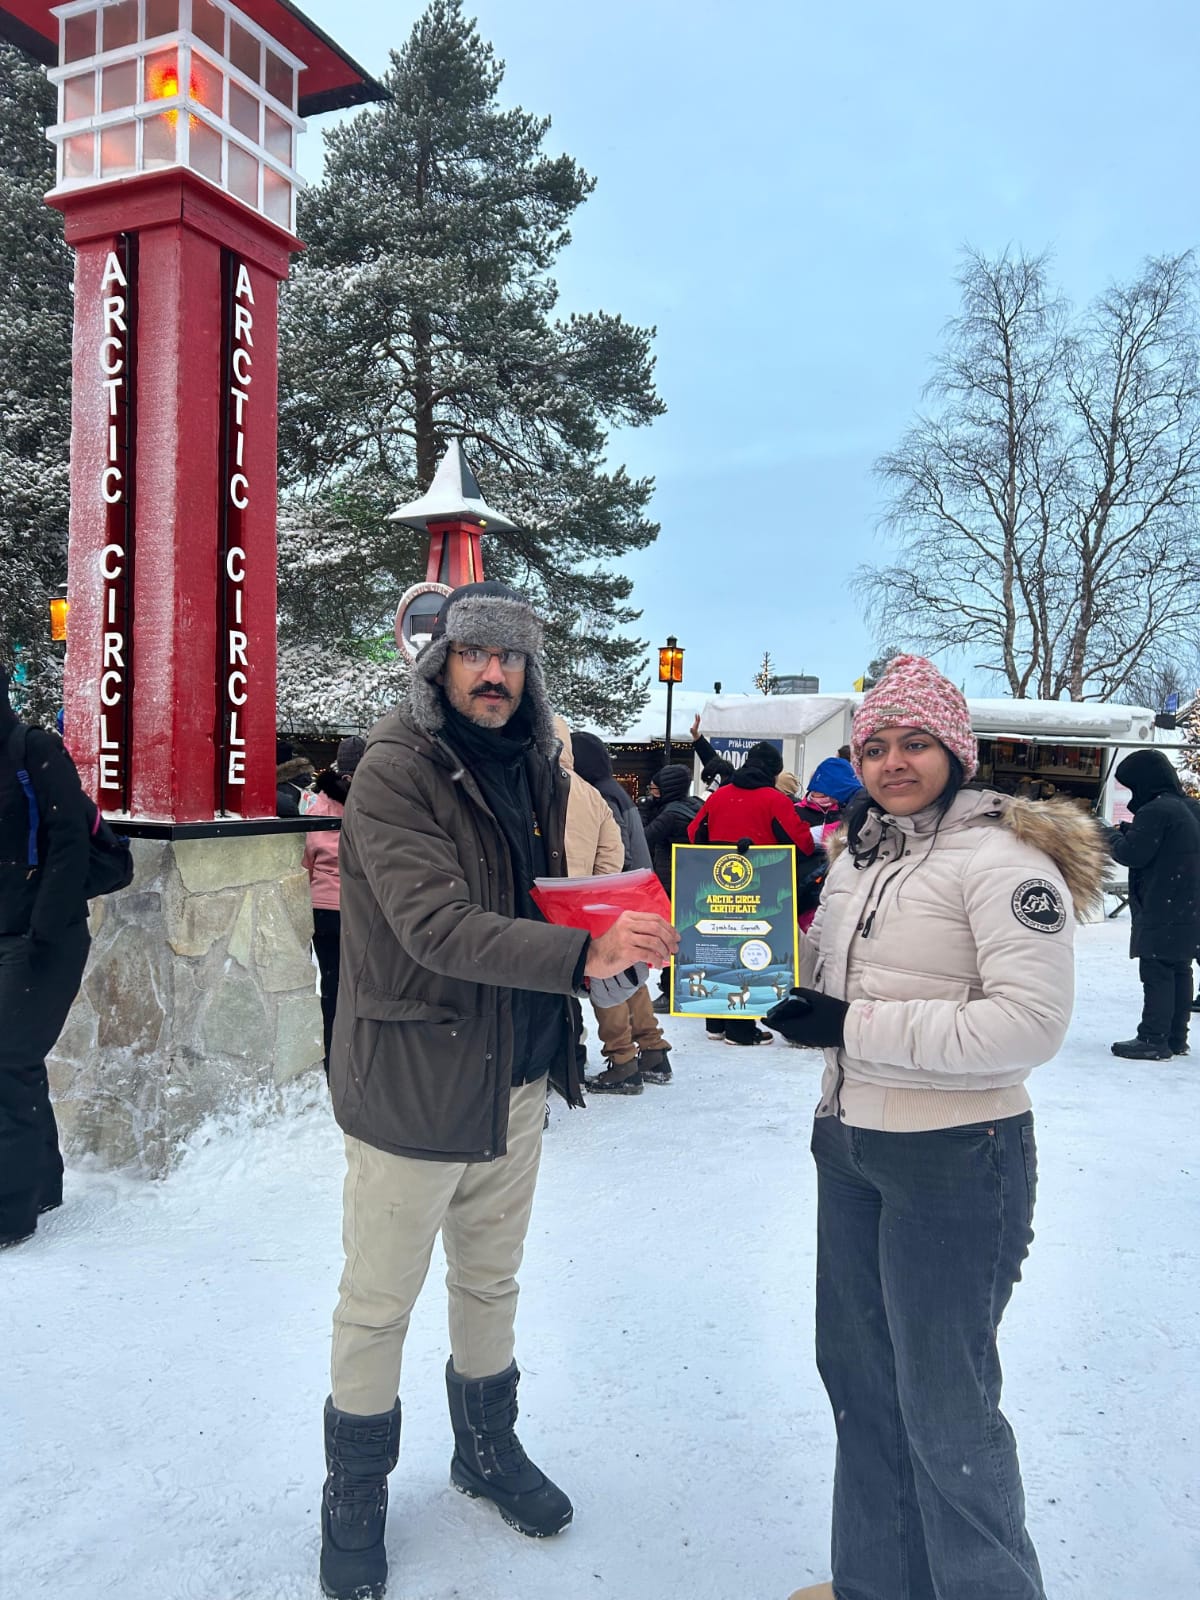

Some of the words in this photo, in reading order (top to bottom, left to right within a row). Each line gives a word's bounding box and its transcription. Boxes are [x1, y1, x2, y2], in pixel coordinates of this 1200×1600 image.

[99, 252, 127, 503] ARCTIC
[230, 264, 254, 509] ARCTIC
[99, 545, 125, 790] CIRCLE
[226, 547, 249, 784] CIRCLE
[706, 895, 733, 904] ARCTIC
[735, 895, 761, 904] CIRCLE
[710, 904, 757, 913] CERTIFICATE
